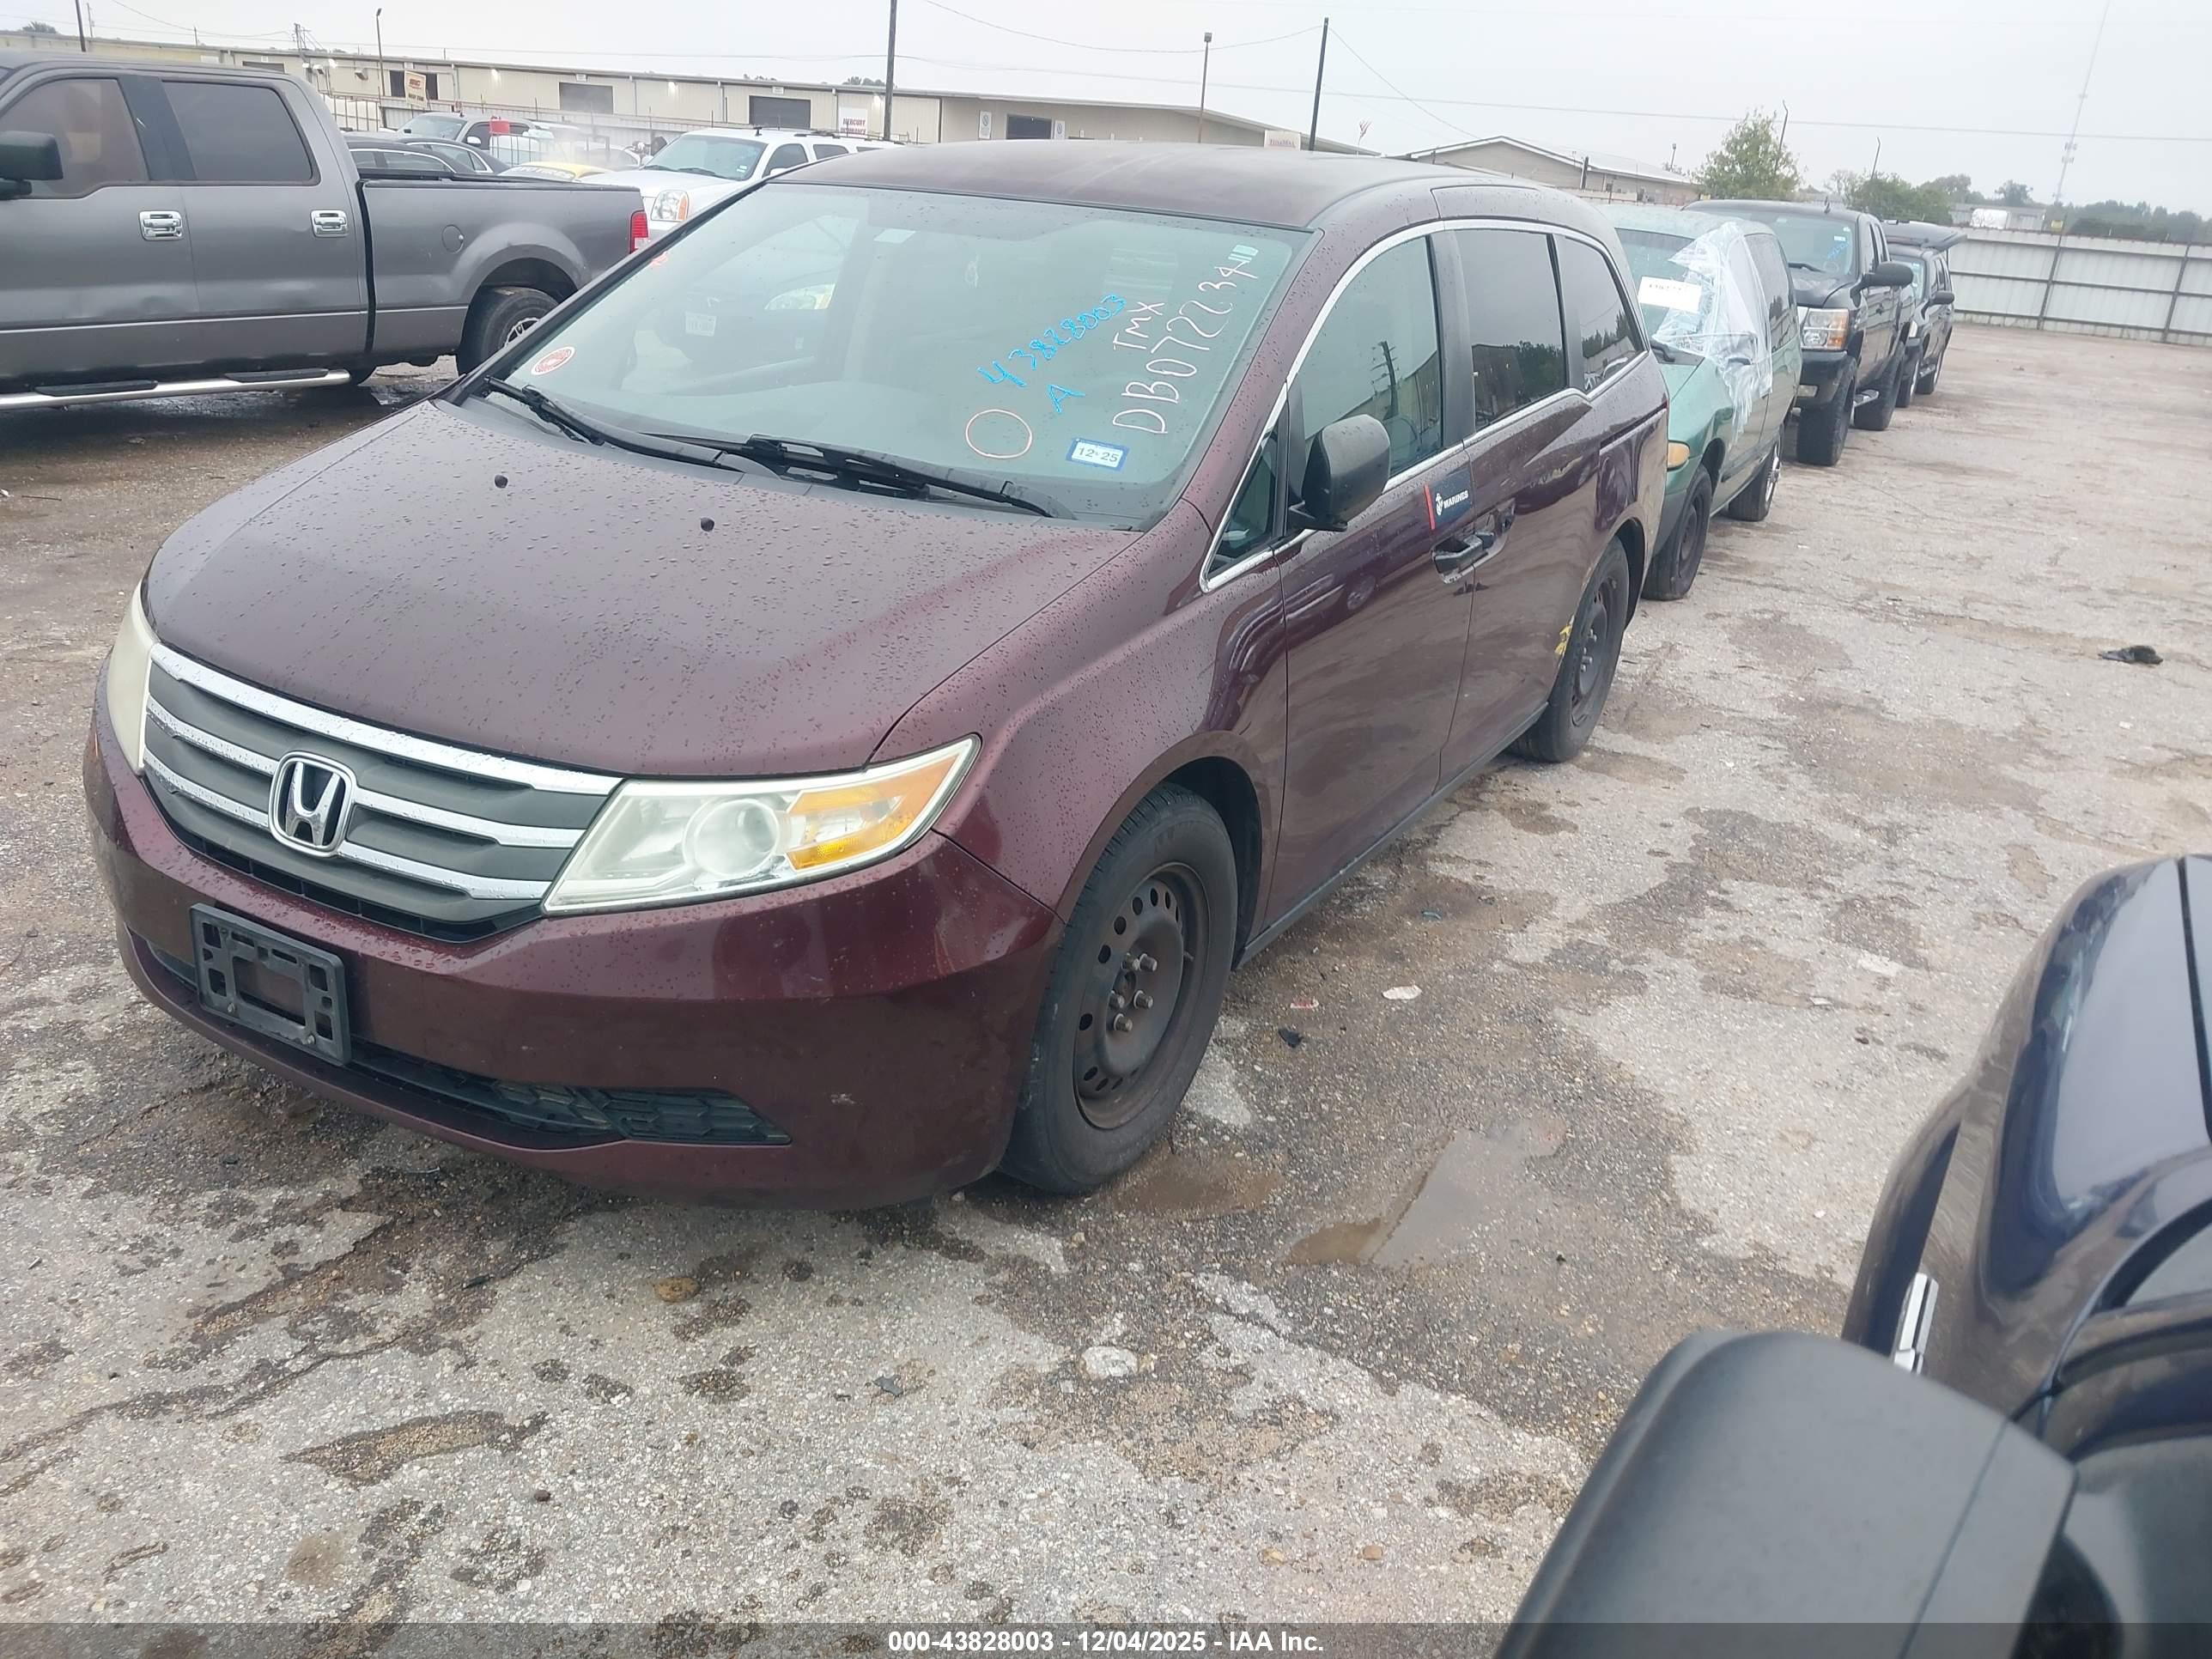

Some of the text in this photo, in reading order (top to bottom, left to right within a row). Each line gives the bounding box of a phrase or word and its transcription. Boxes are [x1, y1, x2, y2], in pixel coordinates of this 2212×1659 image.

[976, 295, 1127, 386] 43828003
[1113, 301, 1164, 350] TMX
[1047, 384, 1086, 414] A
